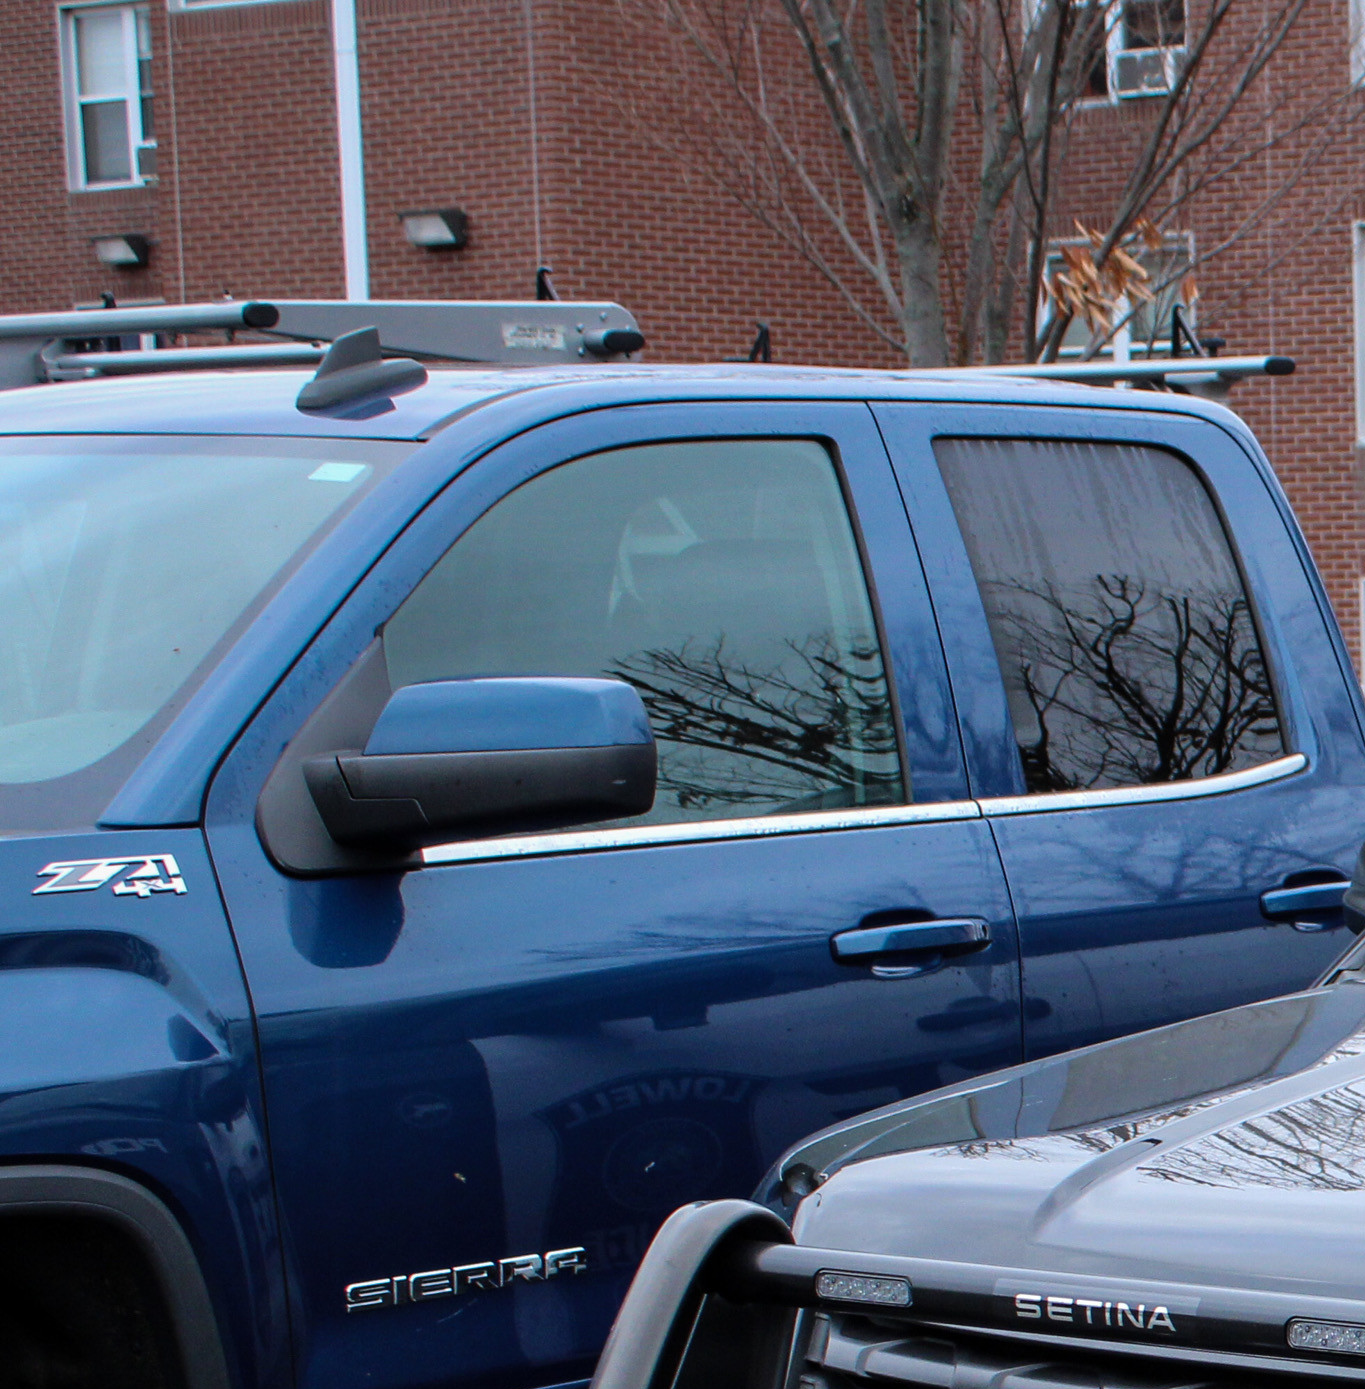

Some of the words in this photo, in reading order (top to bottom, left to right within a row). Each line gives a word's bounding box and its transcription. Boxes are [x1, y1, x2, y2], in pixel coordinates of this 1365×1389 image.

[31, 853, 181, 895] Z71
[344, 1246, 588, 1314] SIERRA
[1014, 1293, 1177, 1333] SETINA
